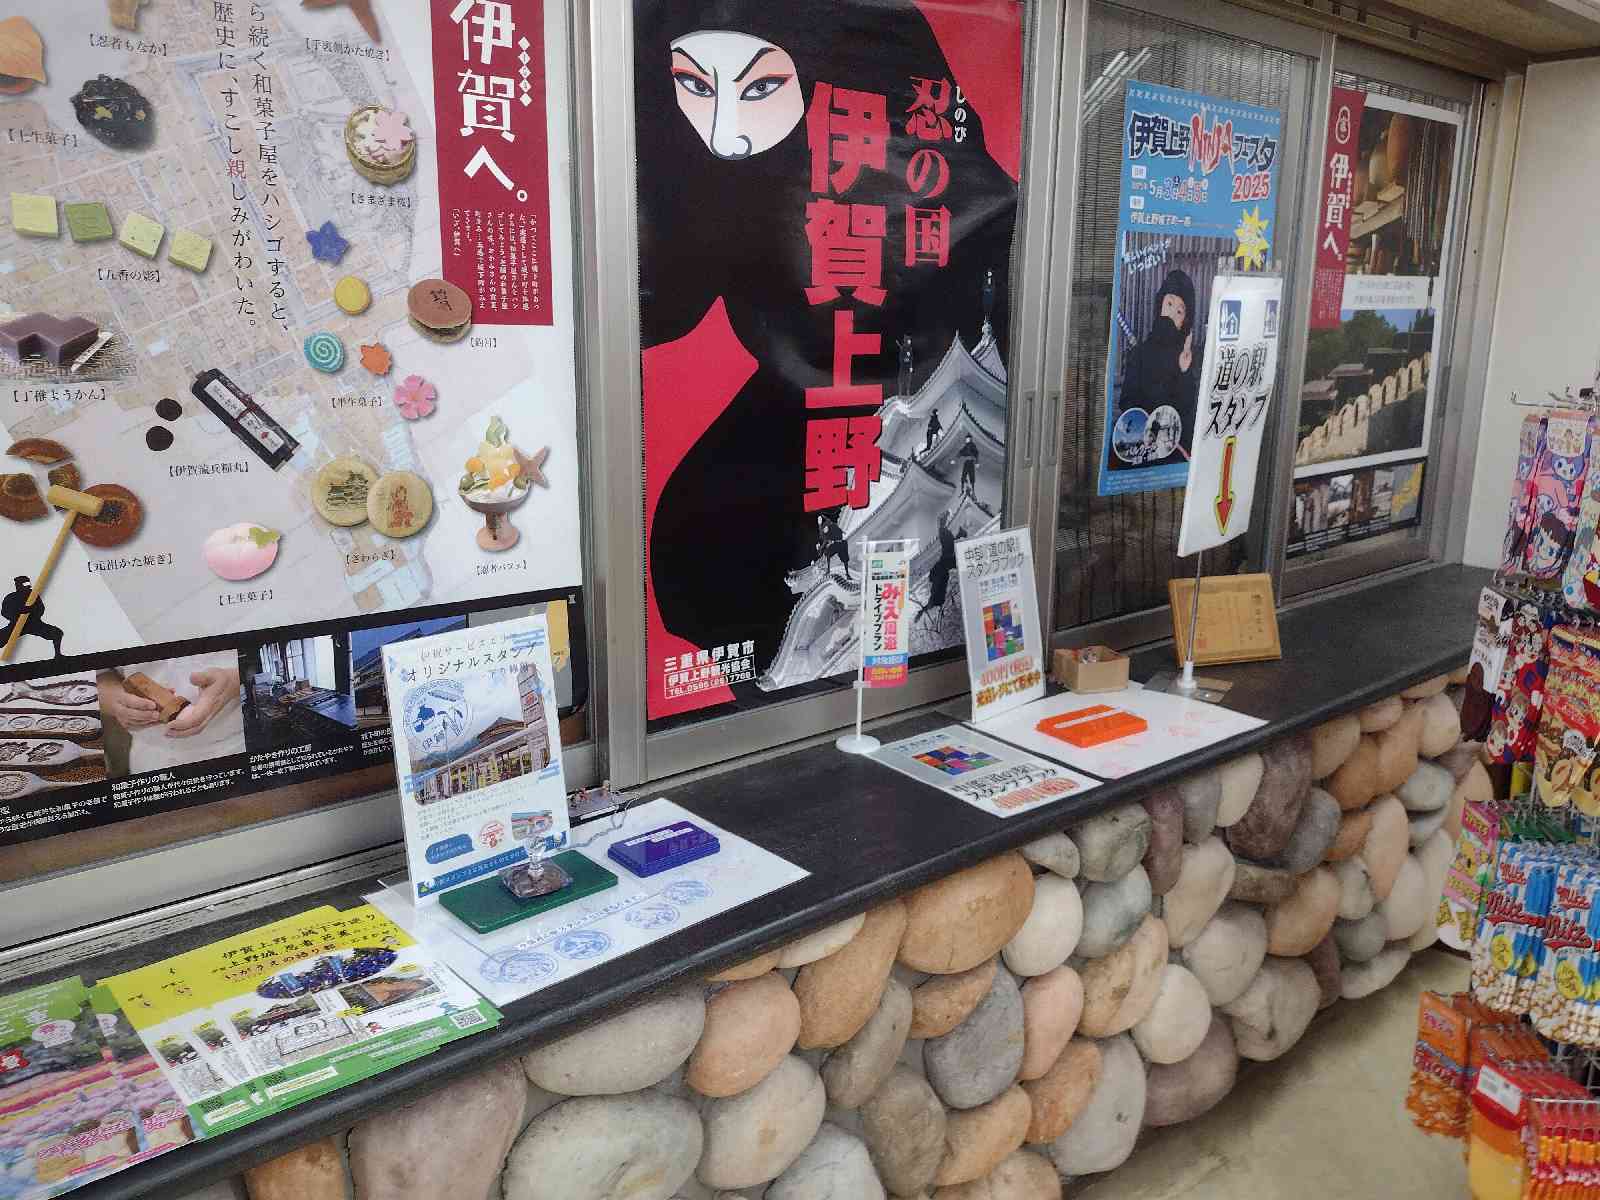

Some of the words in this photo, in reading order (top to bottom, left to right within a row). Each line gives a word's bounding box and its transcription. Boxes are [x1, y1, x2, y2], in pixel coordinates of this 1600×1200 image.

[450, 0, 528, 202] 伊賀へ。
[953, 85, 967, 143] しのび
[213, 1, 257, 327] 歴史に、すこし親しみがわいた。
[905, 76, 952, 267] 忍の国
[1232, 171, 1271, 202] 2025
[804, 80, 891, 511] 伊賀上野
[1213, 343, 1267, 393] 道の駅
[664, 640, 754, 672] 三重県伊賀市
